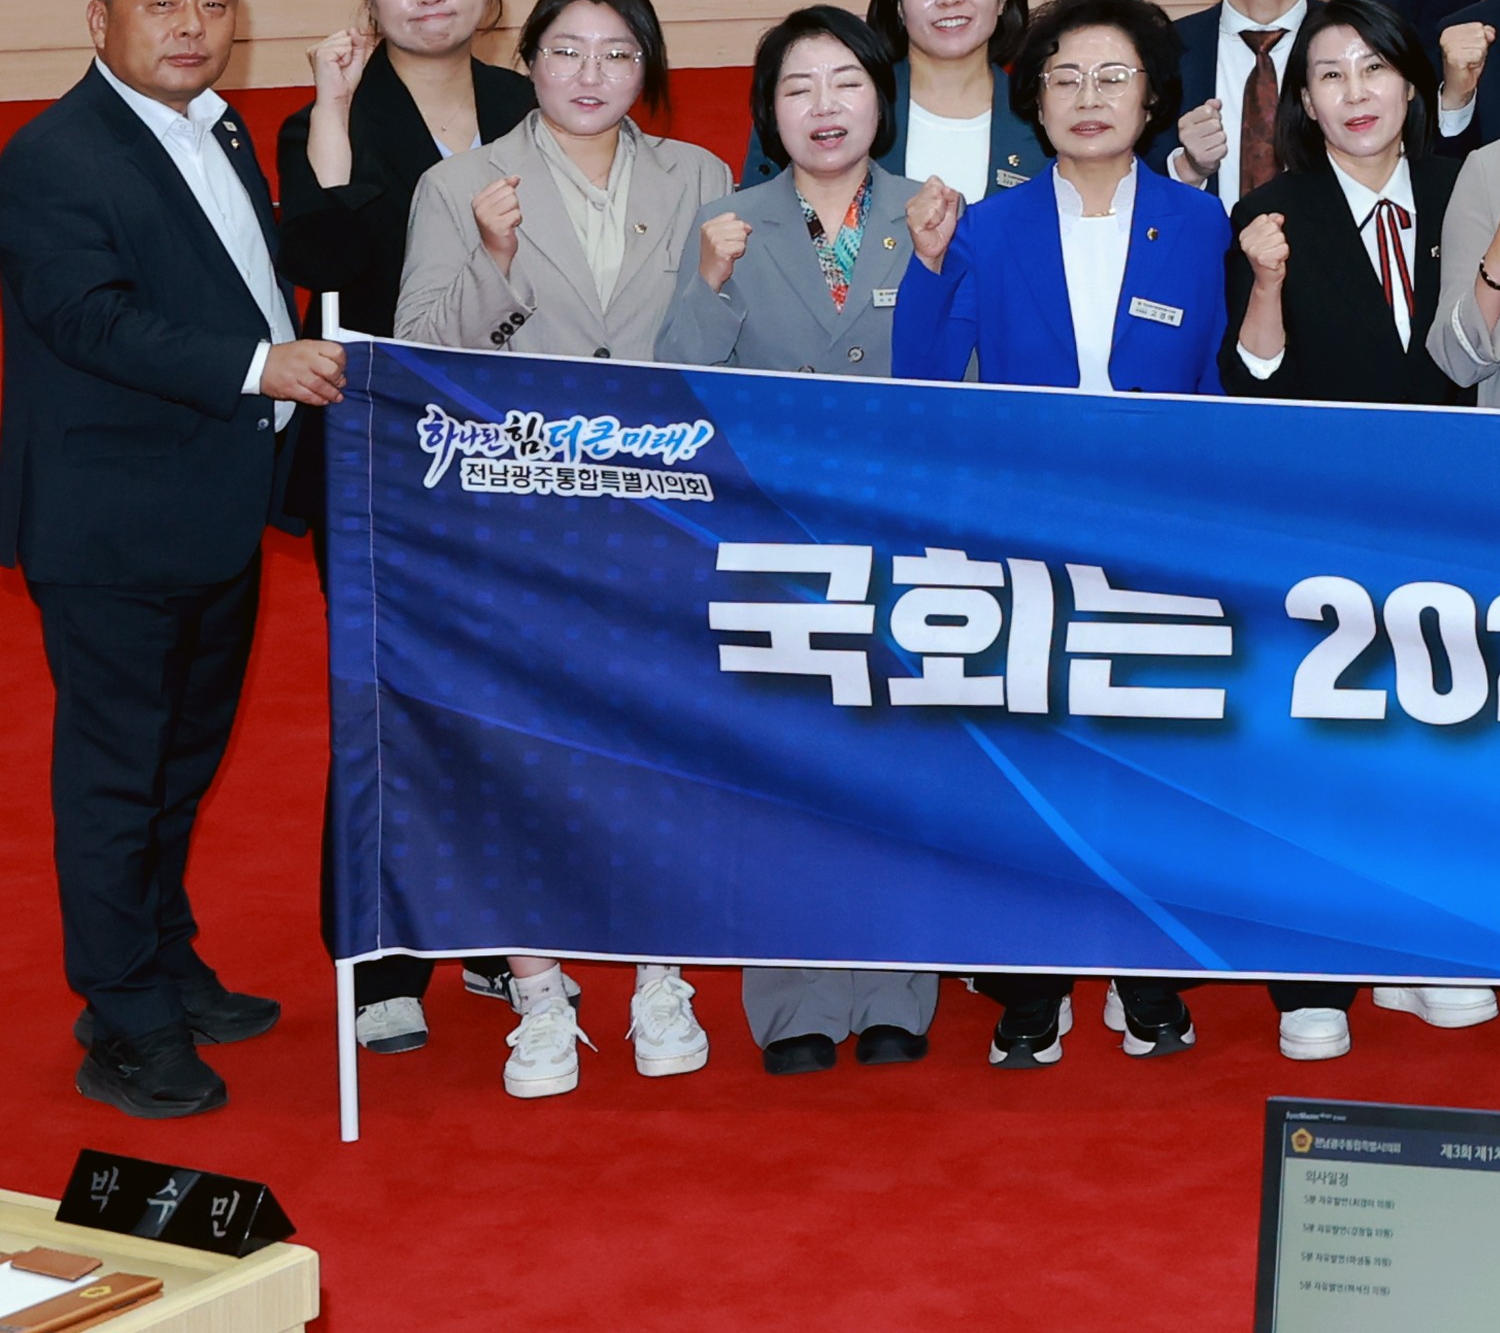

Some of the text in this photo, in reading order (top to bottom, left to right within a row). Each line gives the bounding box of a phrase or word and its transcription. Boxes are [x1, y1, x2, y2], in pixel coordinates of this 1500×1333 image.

[424, 410, 500, 481] 하나된
[549, 420, 583, 461] 더
[583, 420, 616, 449] 큰
[621, 423, 711, 458] 미래!
[465, 462, 709, 497] 전남광주통합특별시의회
[708, 542, 1233, 720] 국회는
[1440, 1143, 1472, 1161] 제3회
